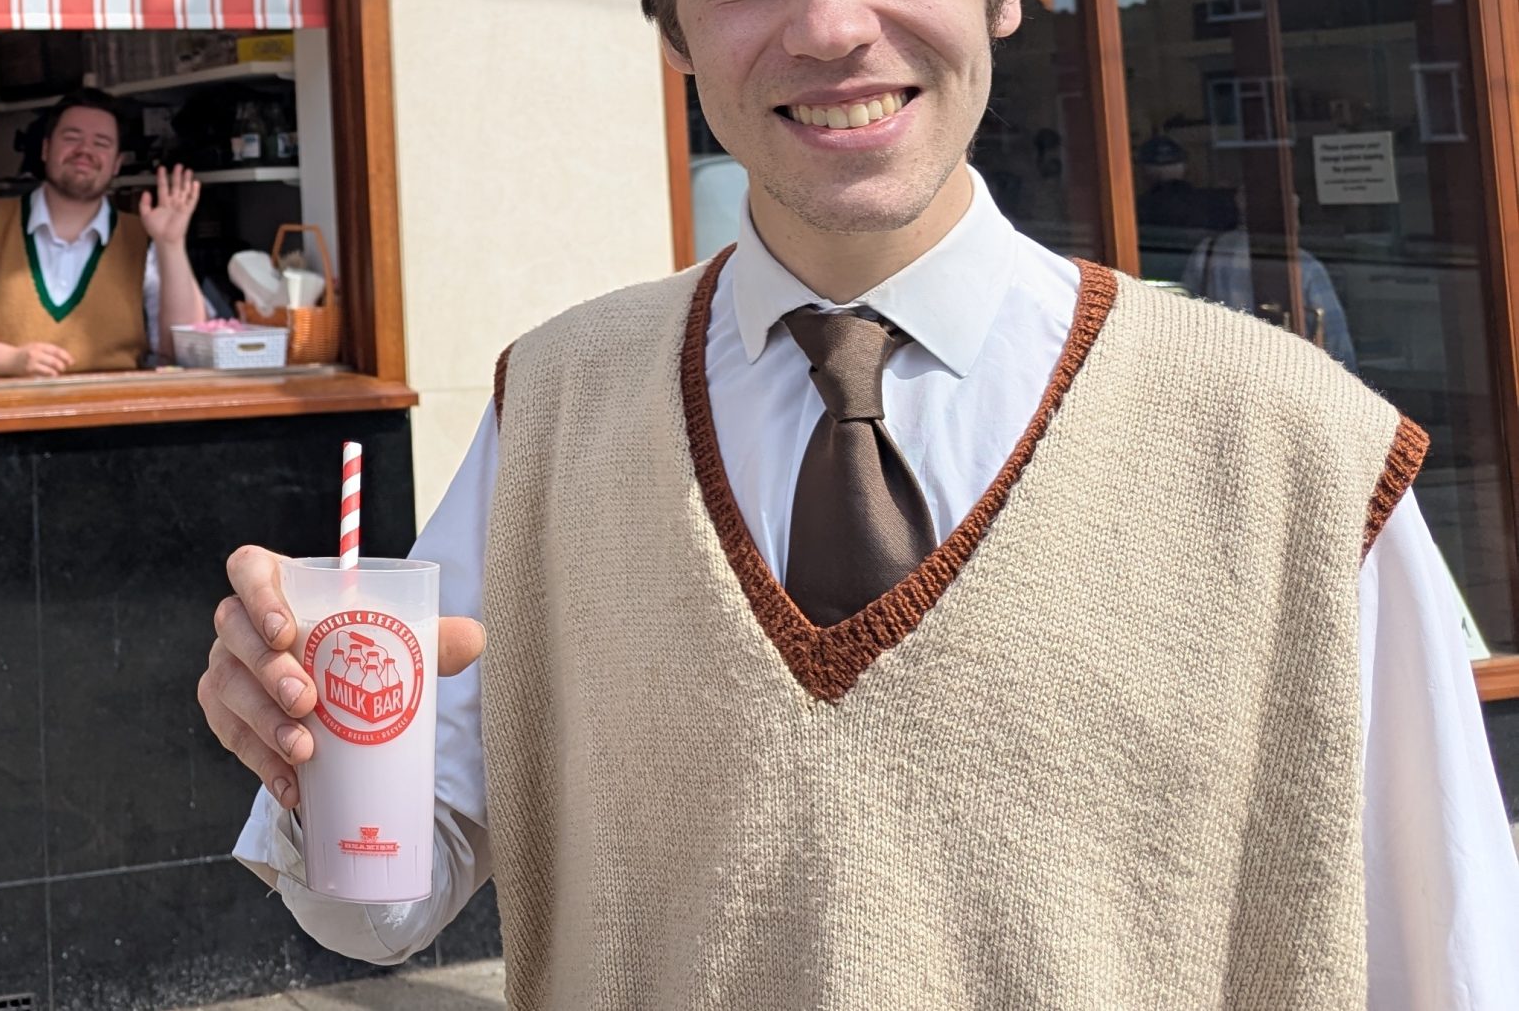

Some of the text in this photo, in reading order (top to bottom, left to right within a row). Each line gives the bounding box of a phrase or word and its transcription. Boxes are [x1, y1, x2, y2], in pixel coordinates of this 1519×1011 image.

[305, 615, 353, 667] HEALTHFUL
[367, 613, 423, 670] REFRESHING
[330, 678, 403, 719] MILK BAR
